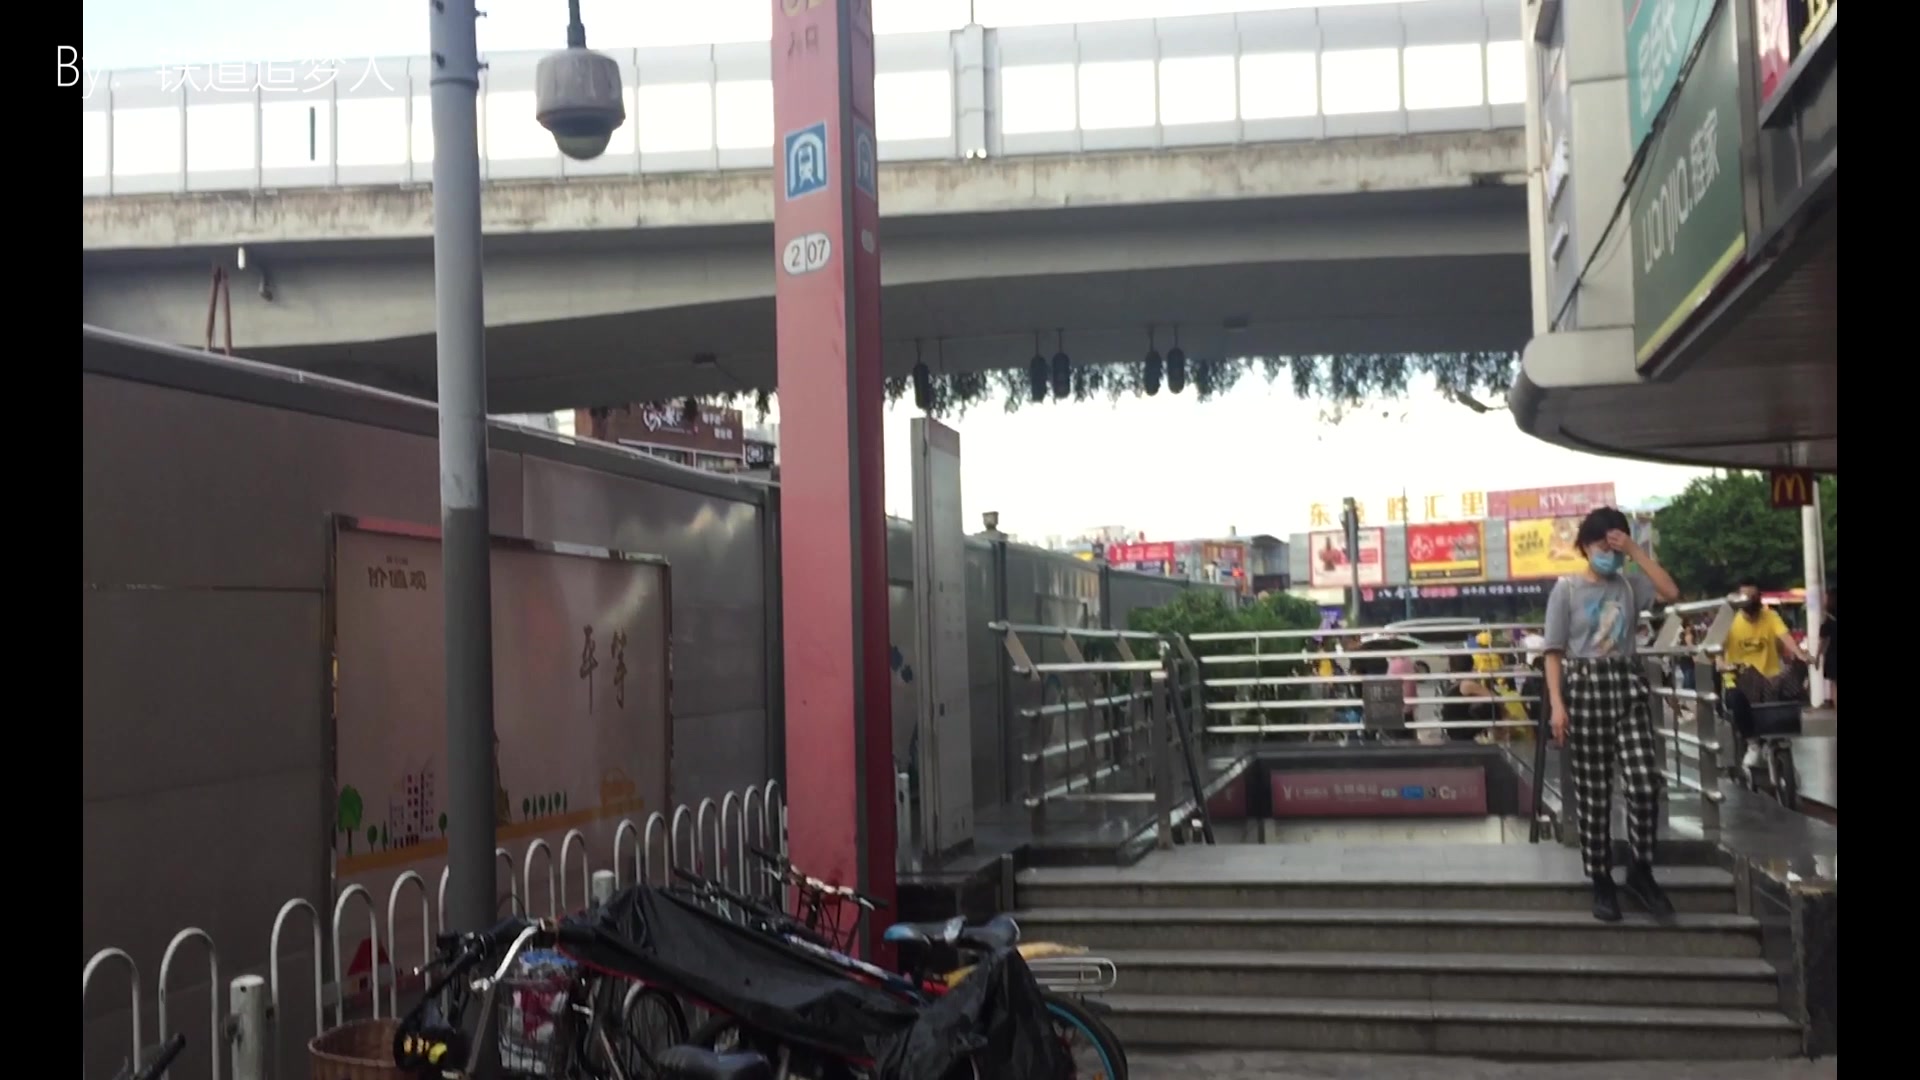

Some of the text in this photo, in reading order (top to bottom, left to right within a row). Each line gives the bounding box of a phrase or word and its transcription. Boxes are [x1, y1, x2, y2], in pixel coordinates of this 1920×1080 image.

[789, 238, 828, 268] 2 07
[1539, 492, 1568, 509] KTV
[367, 566, 428, 593] 价值观
[578, 624, 629, 714] 平等
